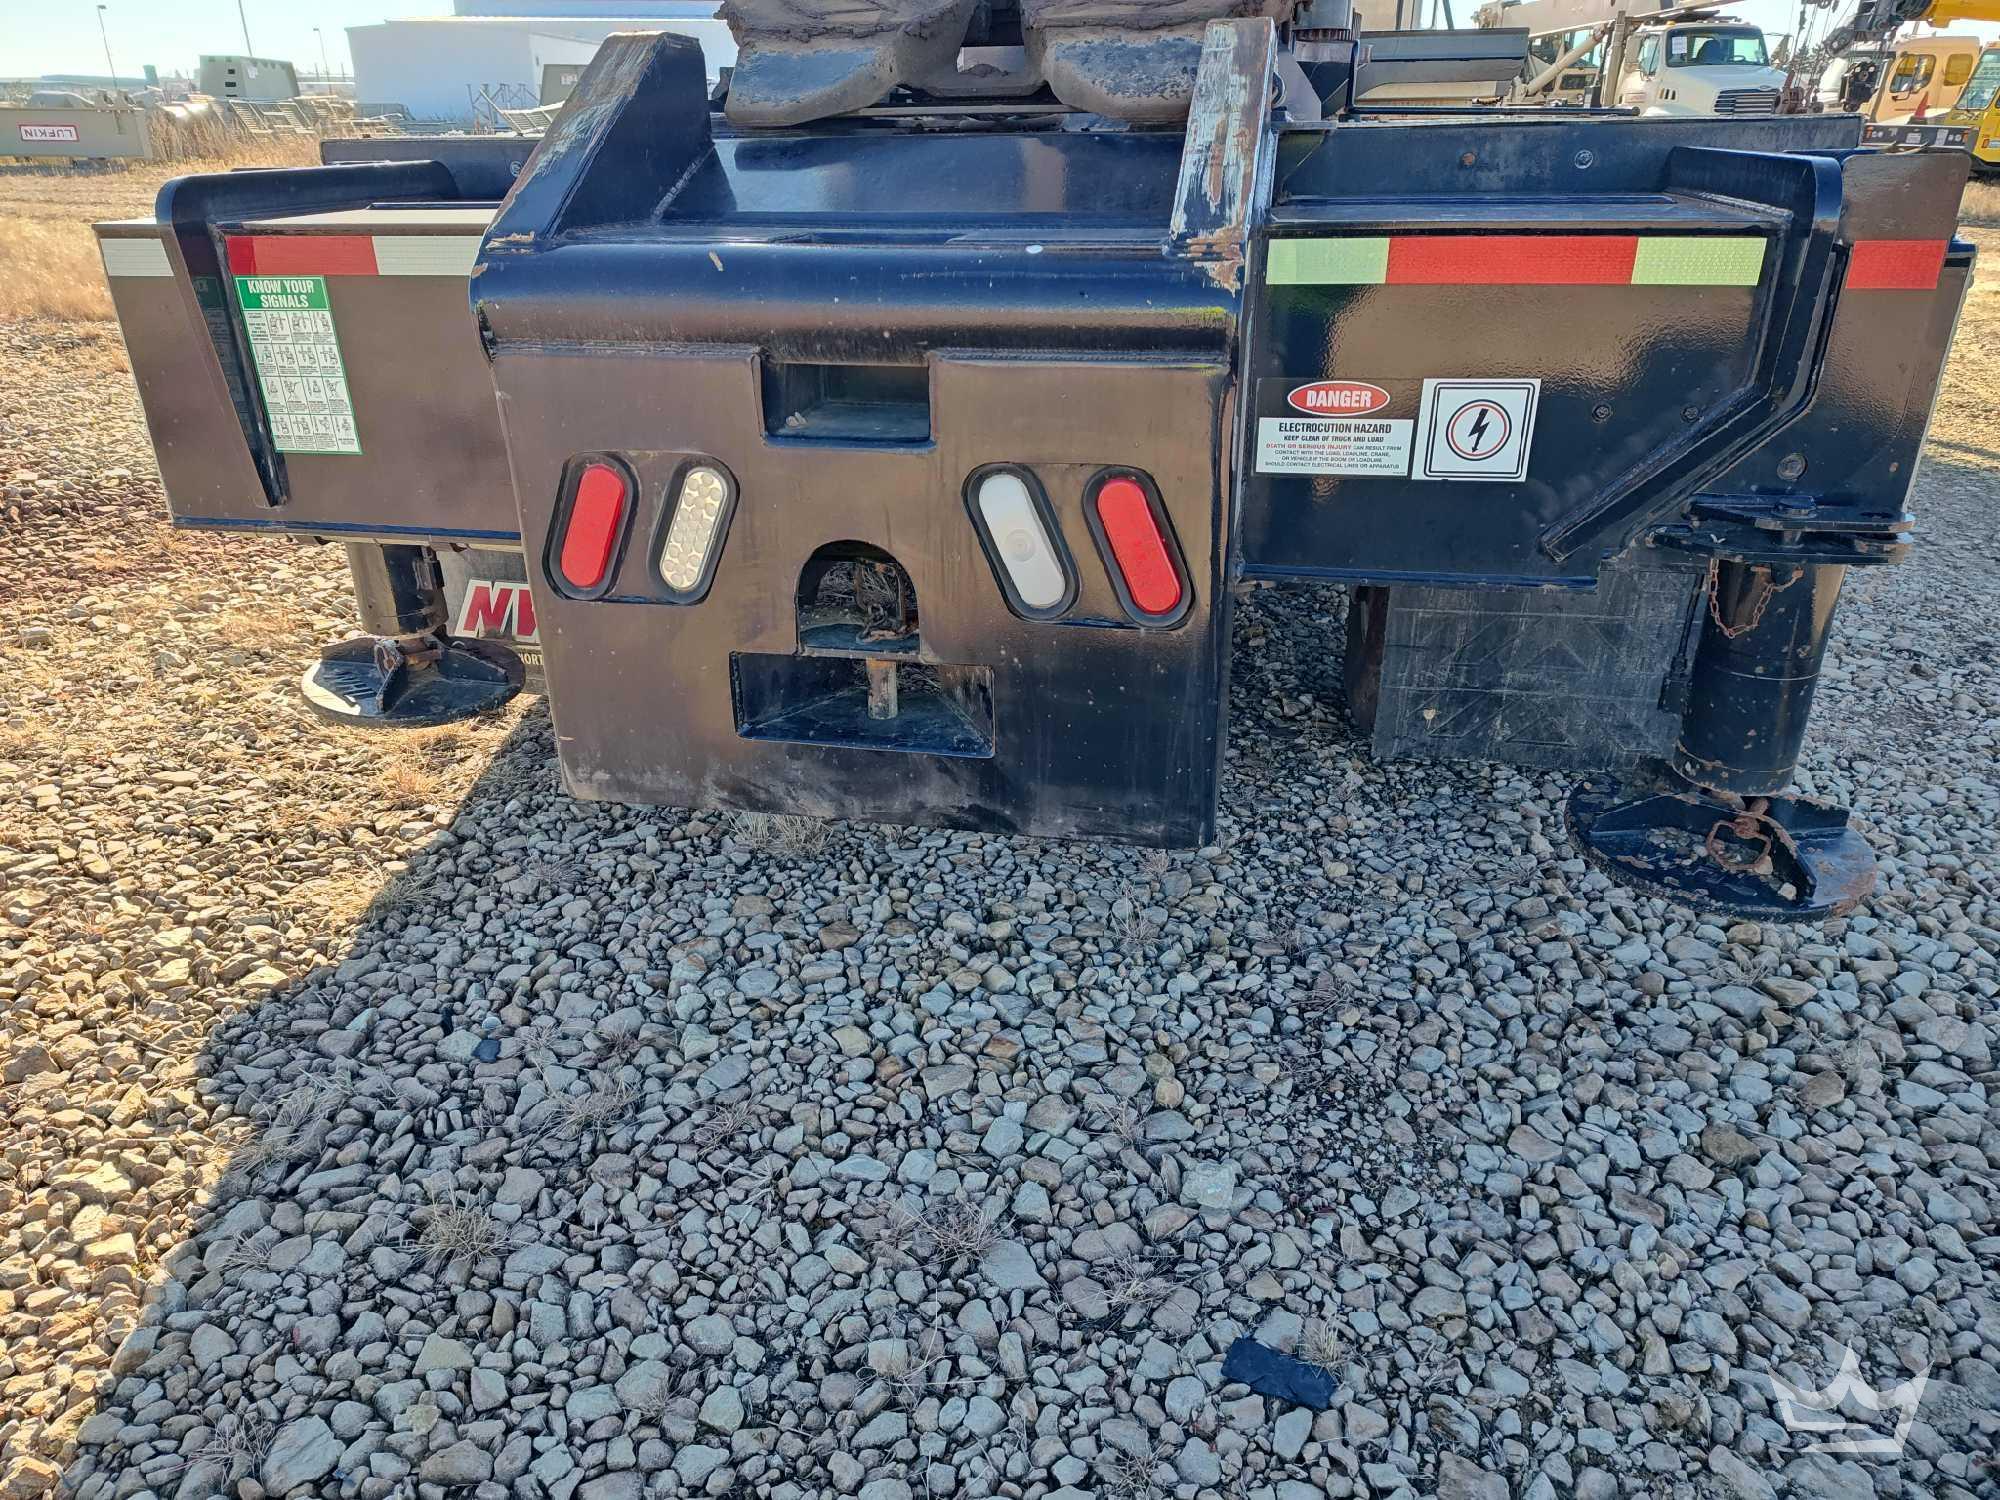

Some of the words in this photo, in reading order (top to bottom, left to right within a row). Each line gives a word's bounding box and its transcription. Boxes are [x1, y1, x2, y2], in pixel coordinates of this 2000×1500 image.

[24, 128, 73, 138] LUFKIN
[247, 280, 281, 293] KNOW
[283, 280, 314, 293] YOUR
[261, 295, 309, 308] SIGNALS
[1306, 390, 1372, 408] DANGER
[1279, 422, 1352, 433] ELECTROCUTION
[1353, 423, 1392, 434] HAZARD
